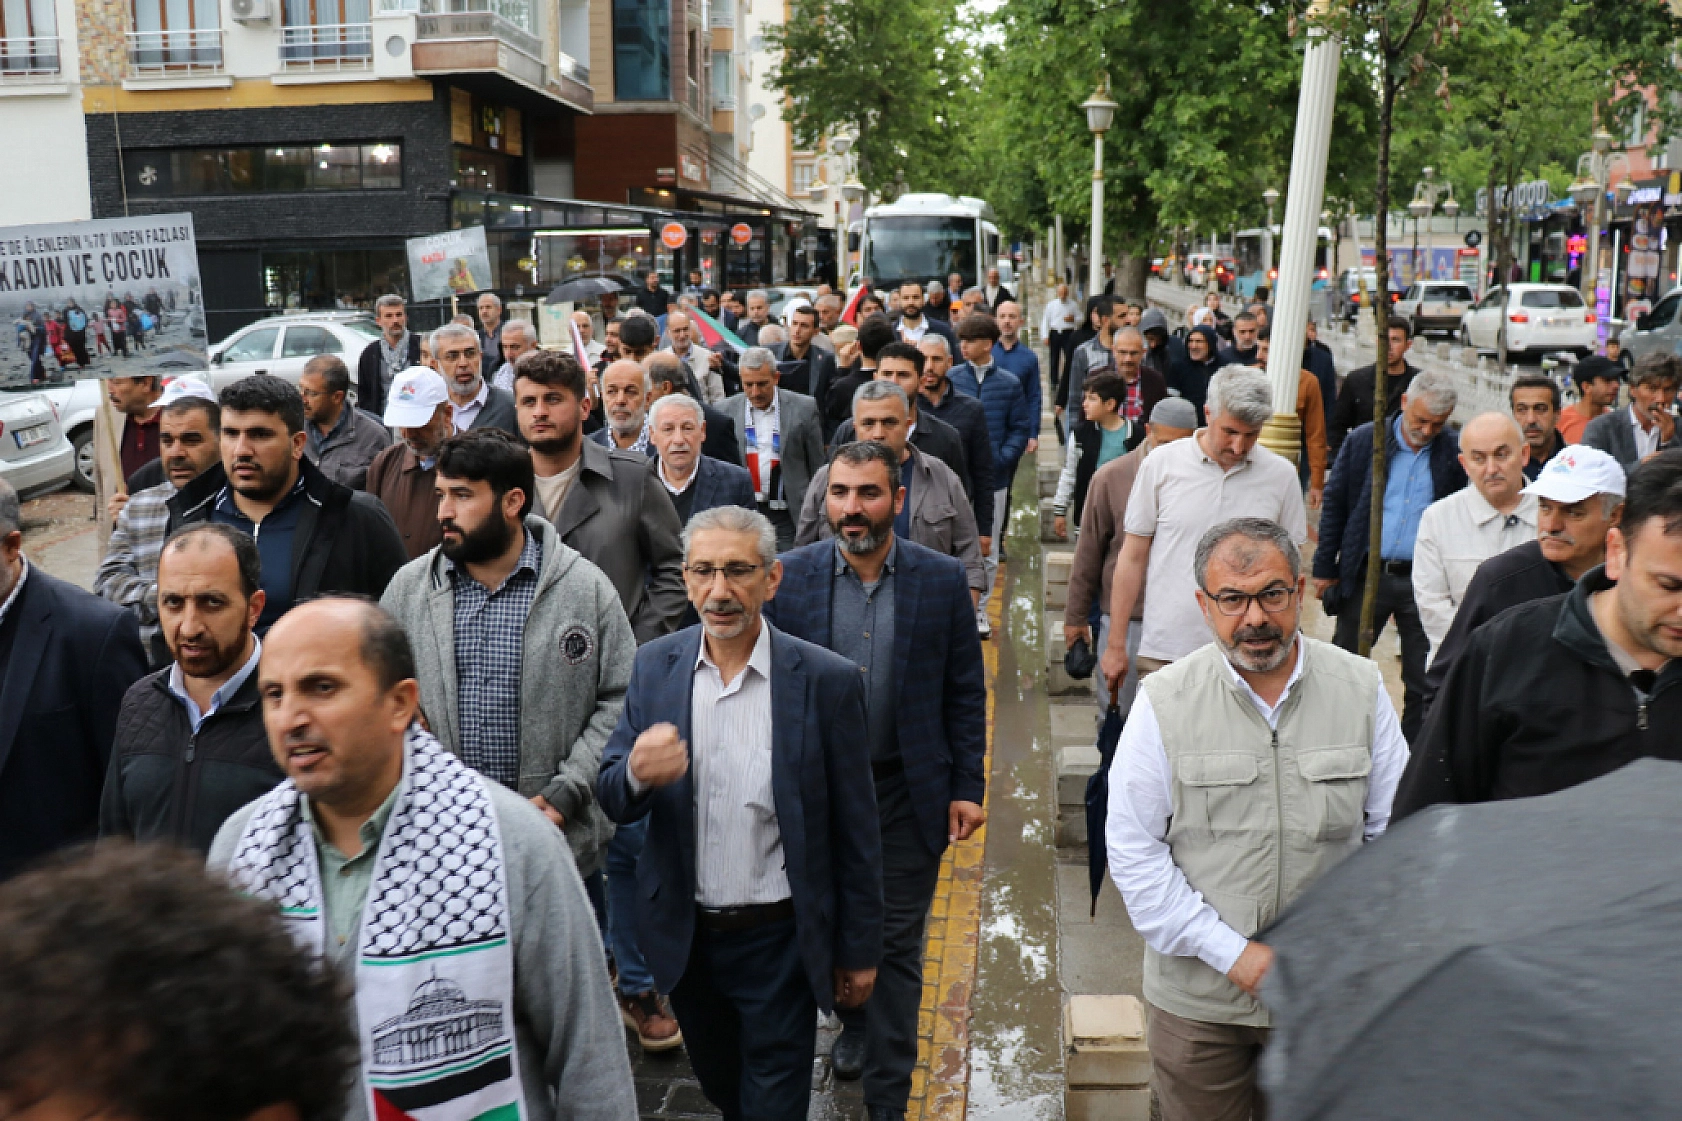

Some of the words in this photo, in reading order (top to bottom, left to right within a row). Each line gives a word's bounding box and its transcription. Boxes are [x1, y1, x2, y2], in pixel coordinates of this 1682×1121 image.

[25, 232, 82, 254] ÖLENLERİN
[145, 226, 190, 244] FAZLASI
[0, 257, 64, 291] KADIN
[70, 253, 96, 285] VE
[102, 247, 170, 289] ÇOCUK
